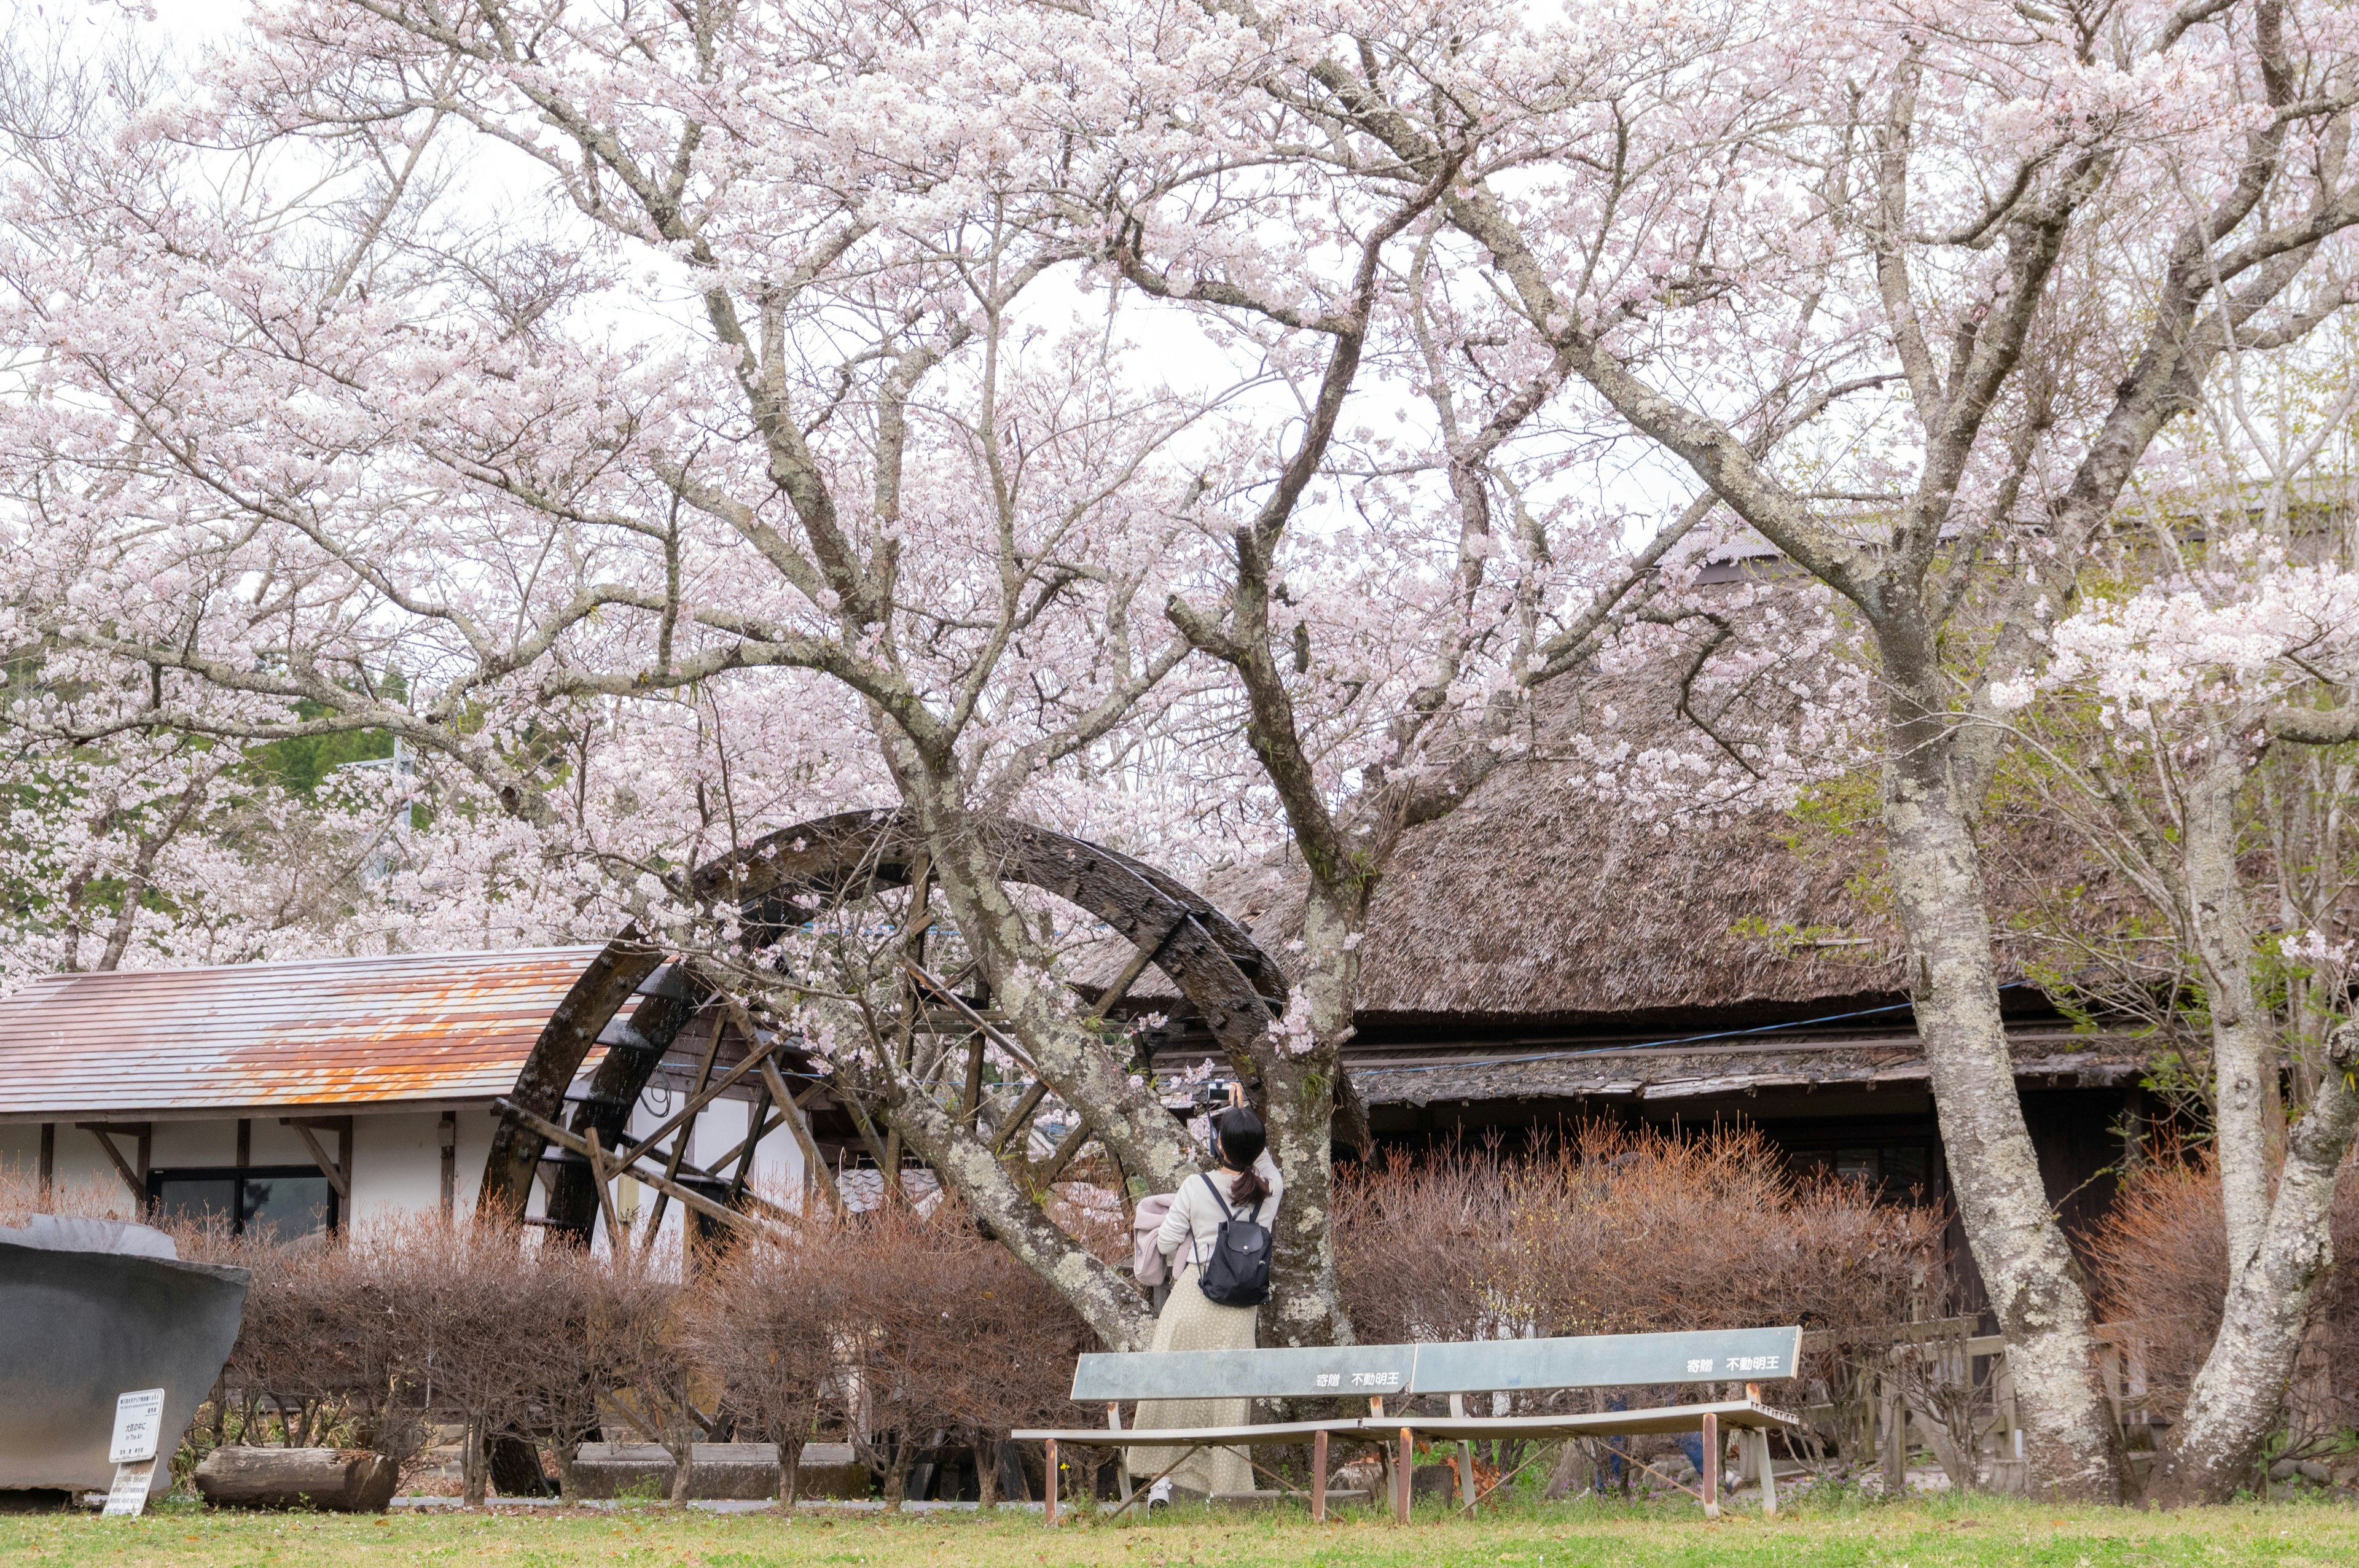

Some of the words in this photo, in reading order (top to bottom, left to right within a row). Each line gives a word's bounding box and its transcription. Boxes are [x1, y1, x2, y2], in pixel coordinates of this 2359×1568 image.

[1686, 1358, 1713, 1373] 寄贈
[1726, 1355, 1780, 1371] 不動明王
[1316, 1373, 1340, 1387] 寄贈
[1351, 1371, 1399, 1386] 不動明王
[125, 1422, 146, 1432] 大気の中に
